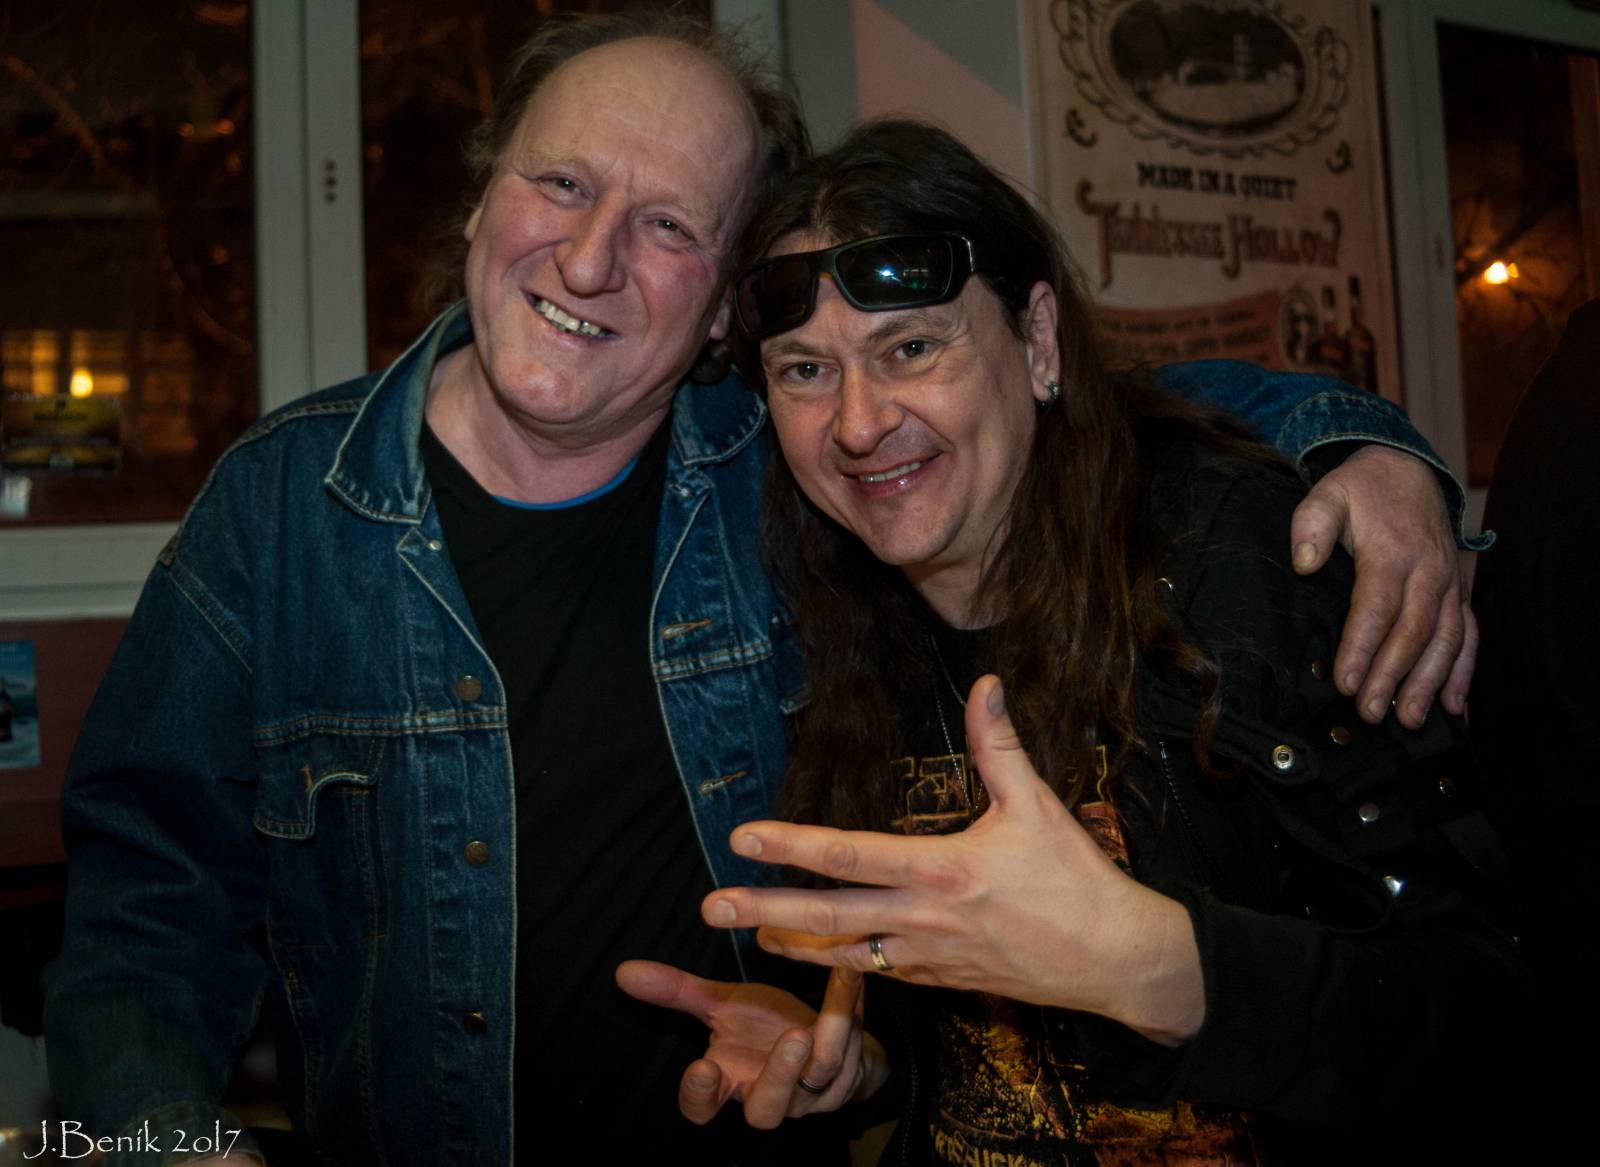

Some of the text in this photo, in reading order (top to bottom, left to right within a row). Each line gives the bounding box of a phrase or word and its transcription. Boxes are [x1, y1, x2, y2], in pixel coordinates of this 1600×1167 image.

[1137, 162, 1298, 201] MADE IN A QUIET
[1222, 207, 1342, 280] HOLLOW
